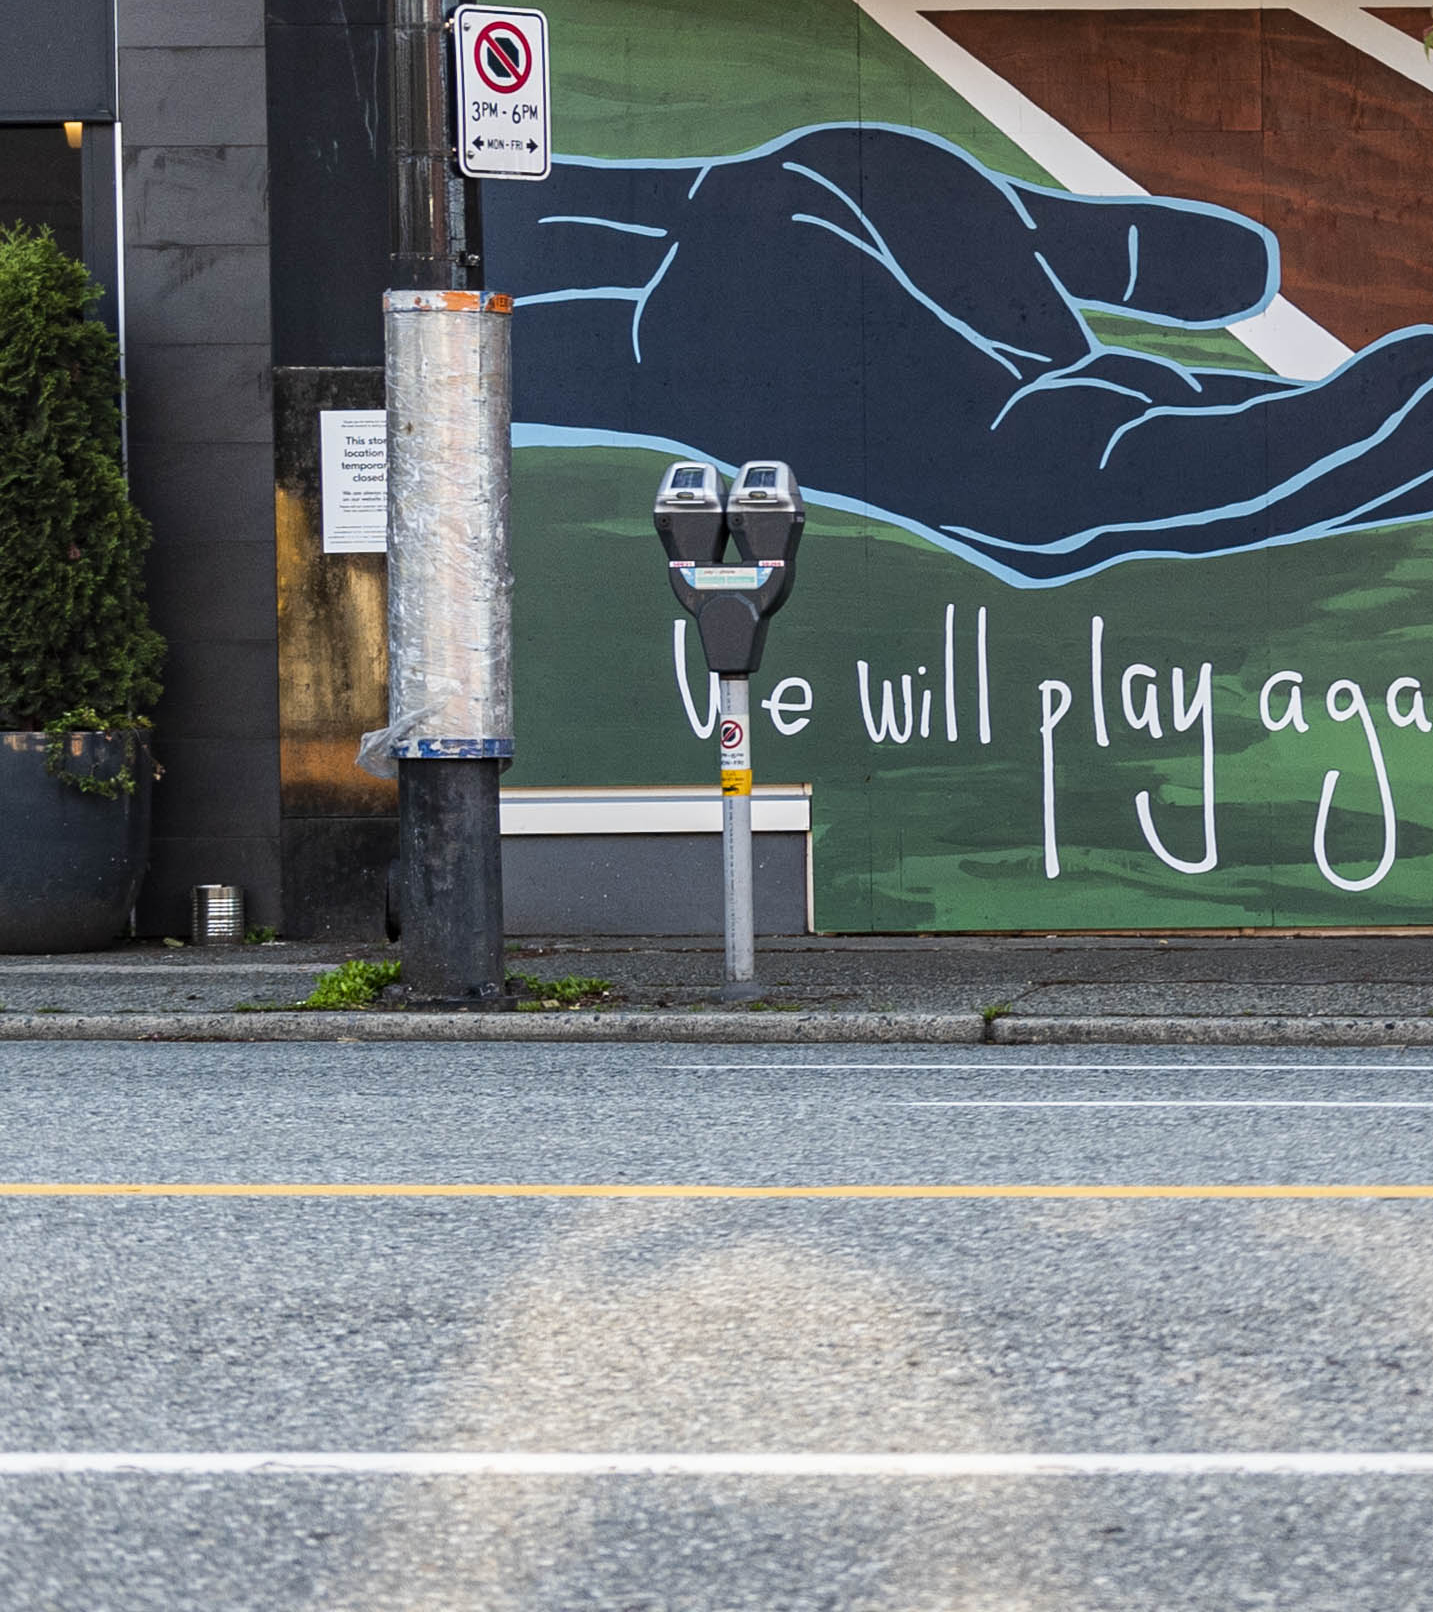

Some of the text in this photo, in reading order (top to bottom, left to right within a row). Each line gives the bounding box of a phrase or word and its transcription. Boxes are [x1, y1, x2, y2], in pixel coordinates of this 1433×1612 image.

[472, 101, 498, 121] 3PM
[512, 104, 538, 124] 6PM
[487, 139, 523, 150] MON-FRI
[345, 436, 387, 445] This stor
[344, 448, 384, 458] location
[341, 461, 388, 471] temporar
[856, 603, 992, 744] will
[1038, 615, 1219, 880] play
